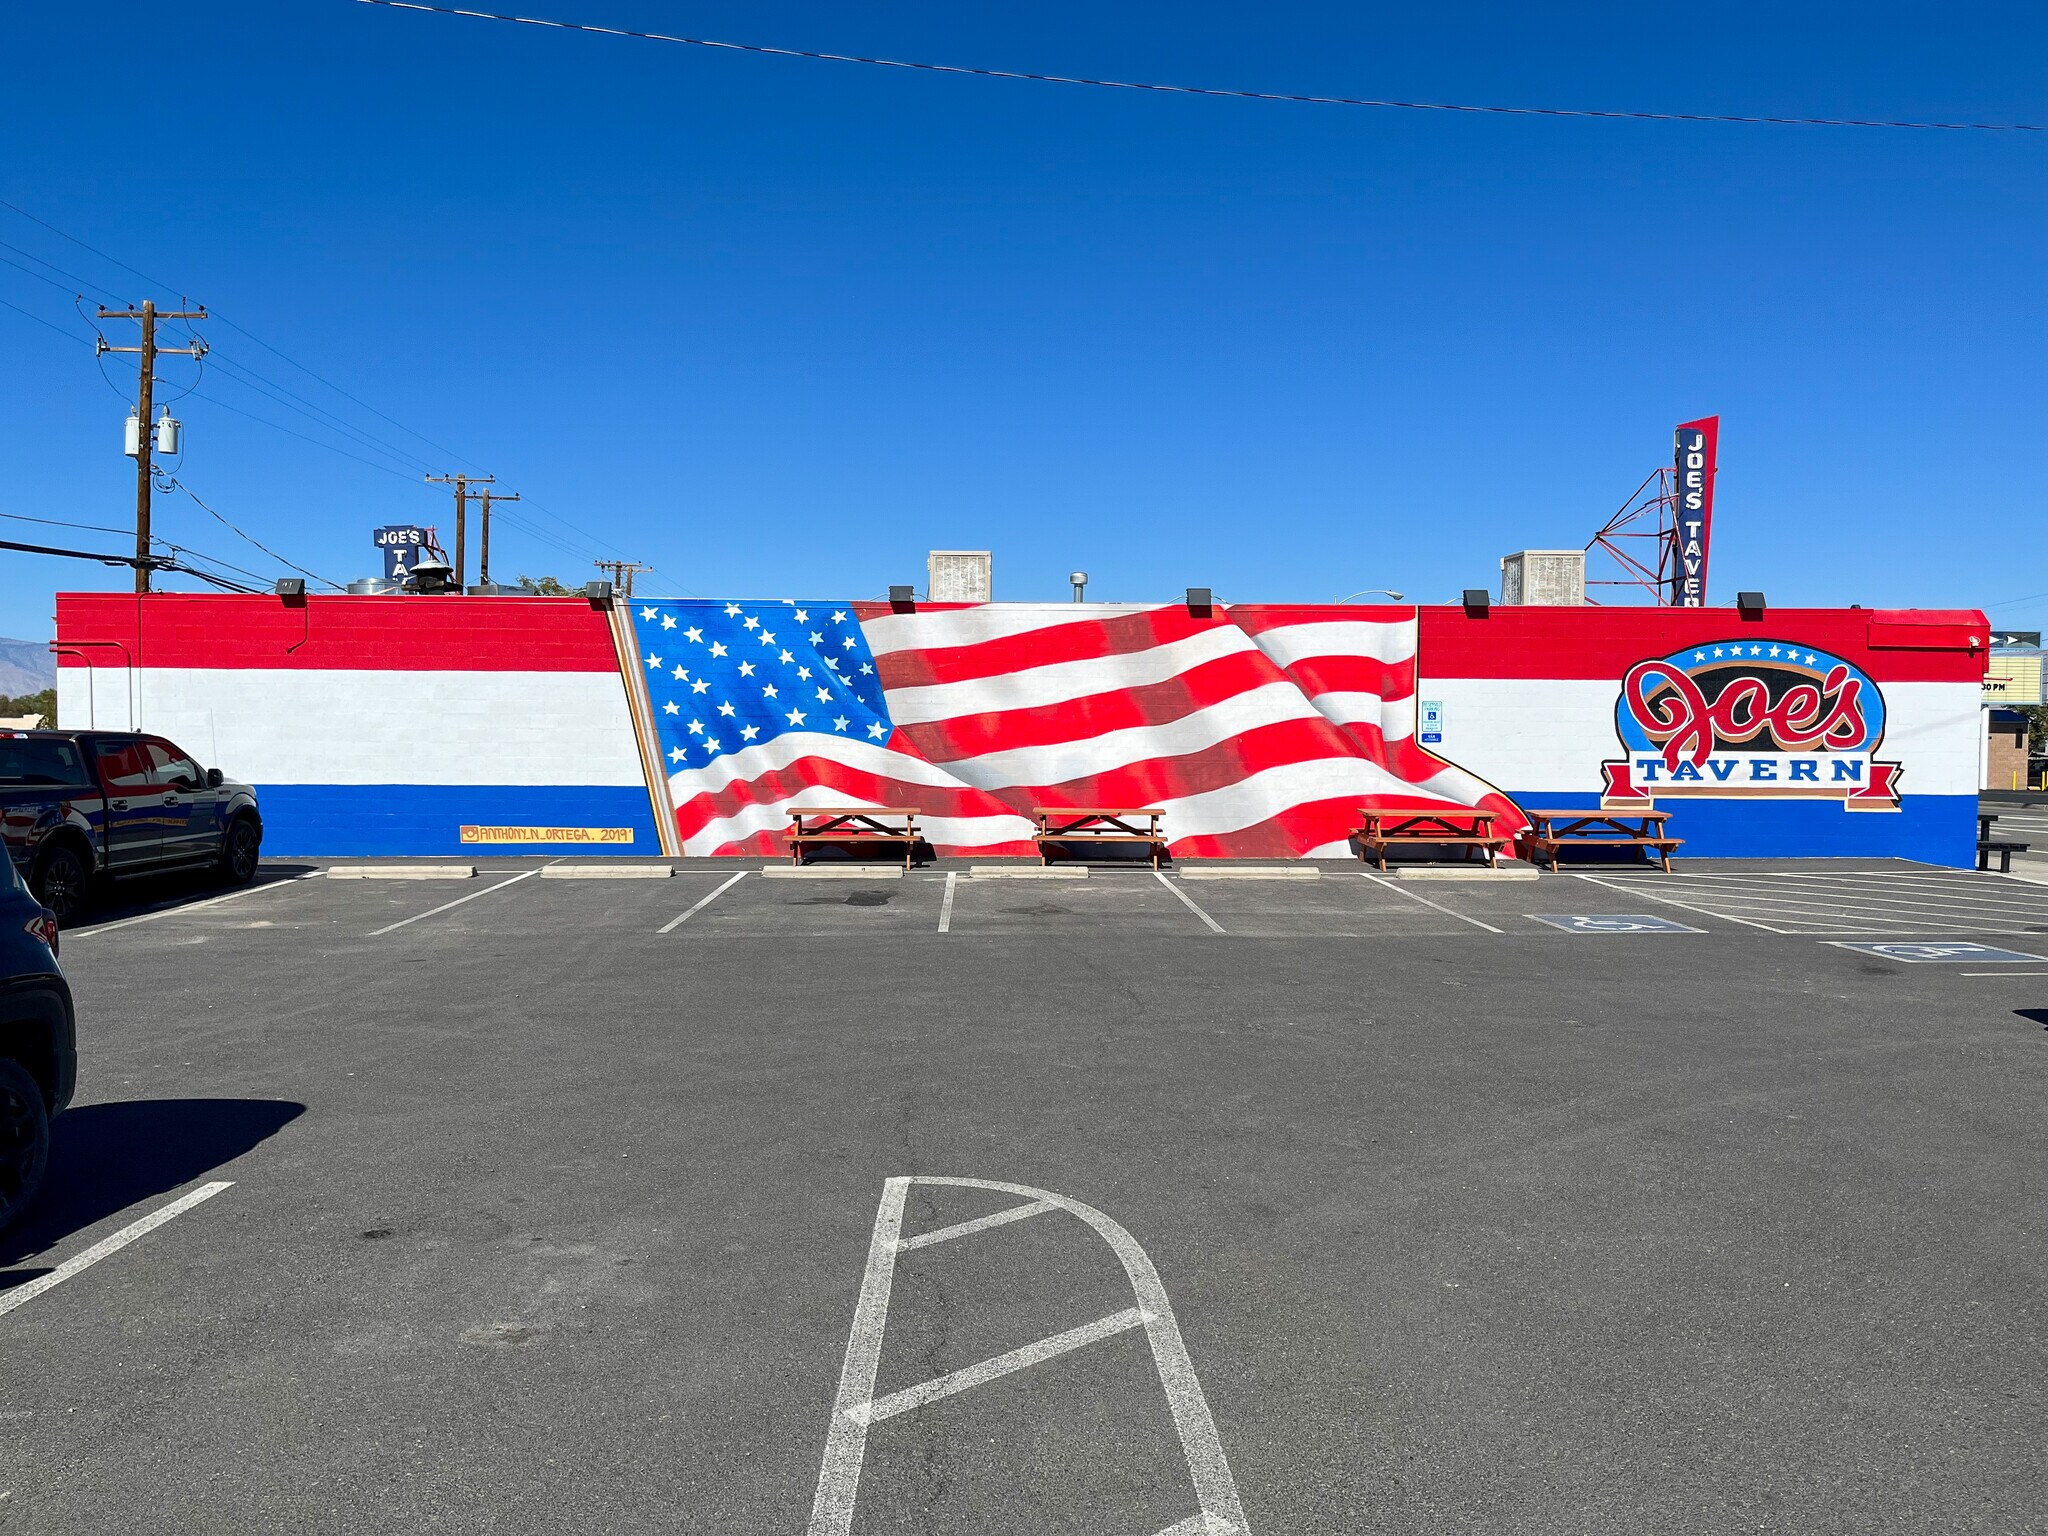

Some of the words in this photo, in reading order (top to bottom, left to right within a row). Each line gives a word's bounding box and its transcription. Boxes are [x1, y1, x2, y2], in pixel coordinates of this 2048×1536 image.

[1685, 434, 1703, 510] JOE'S
[377, 529, 420, 545] JOE'S
[1993, 683, 2005, 691] PM
[1624, 660, 1868, 774] Joe's
[1636, 759, 1864, 782] TAVERN
